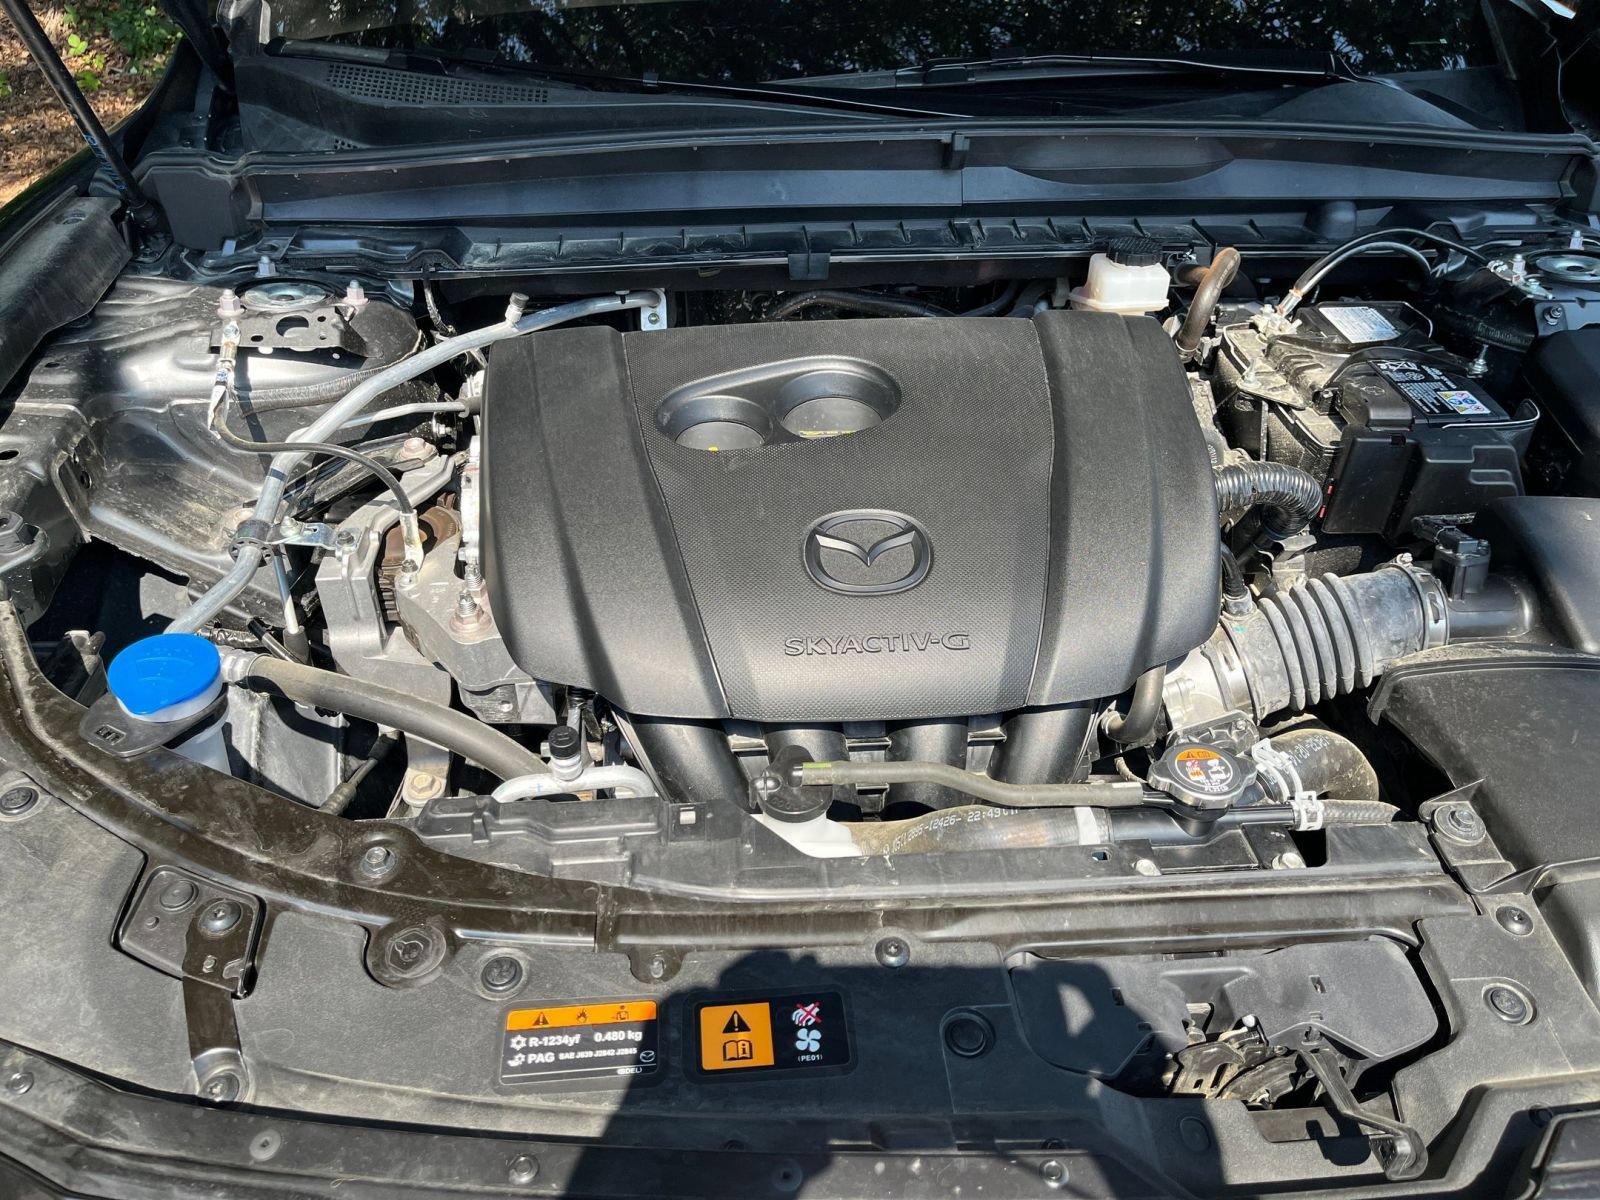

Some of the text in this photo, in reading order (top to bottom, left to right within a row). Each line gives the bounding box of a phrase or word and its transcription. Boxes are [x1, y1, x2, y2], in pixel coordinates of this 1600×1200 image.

[784, 632, 970, 656] SKYACTIV-G
[528, 1029, 643, 1048] R-1234yf 0.480 kg
[527, 1052, 555, 1064] PAG
